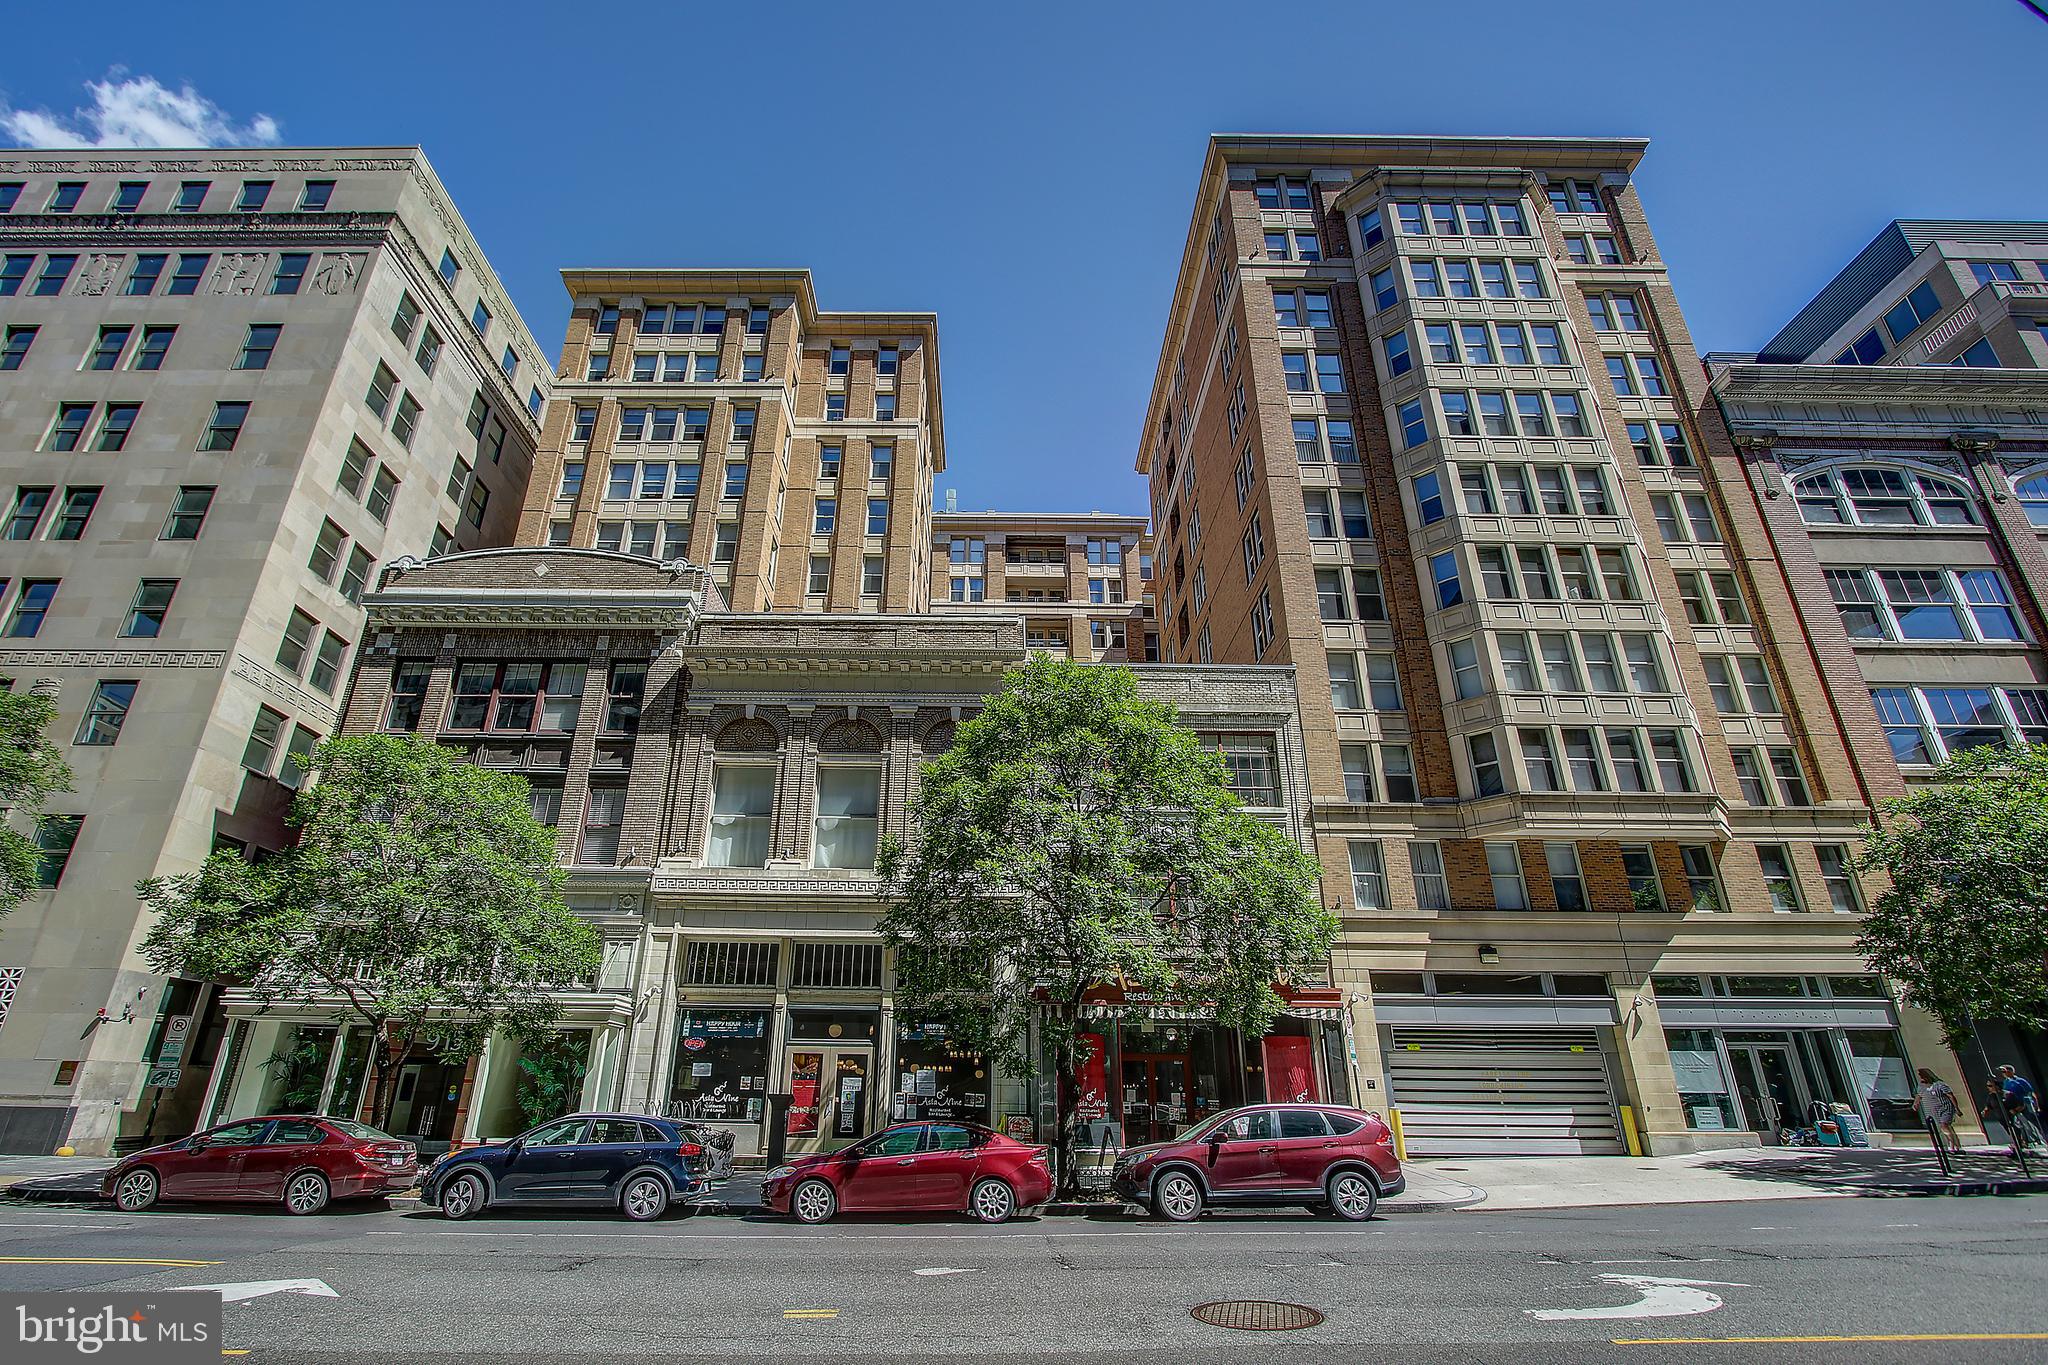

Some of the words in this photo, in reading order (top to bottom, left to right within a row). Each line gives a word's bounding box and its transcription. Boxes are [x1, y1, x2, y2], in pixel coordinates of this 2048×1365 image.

[685, 1040, 705, 1048] OPEN
[695, 1093, 715, 1102] Asia
[715, 1093, 739, 1102] Nine
[918, 1097, 938, 1106] Asia
[938, 1097, 962, 1106] Nine
